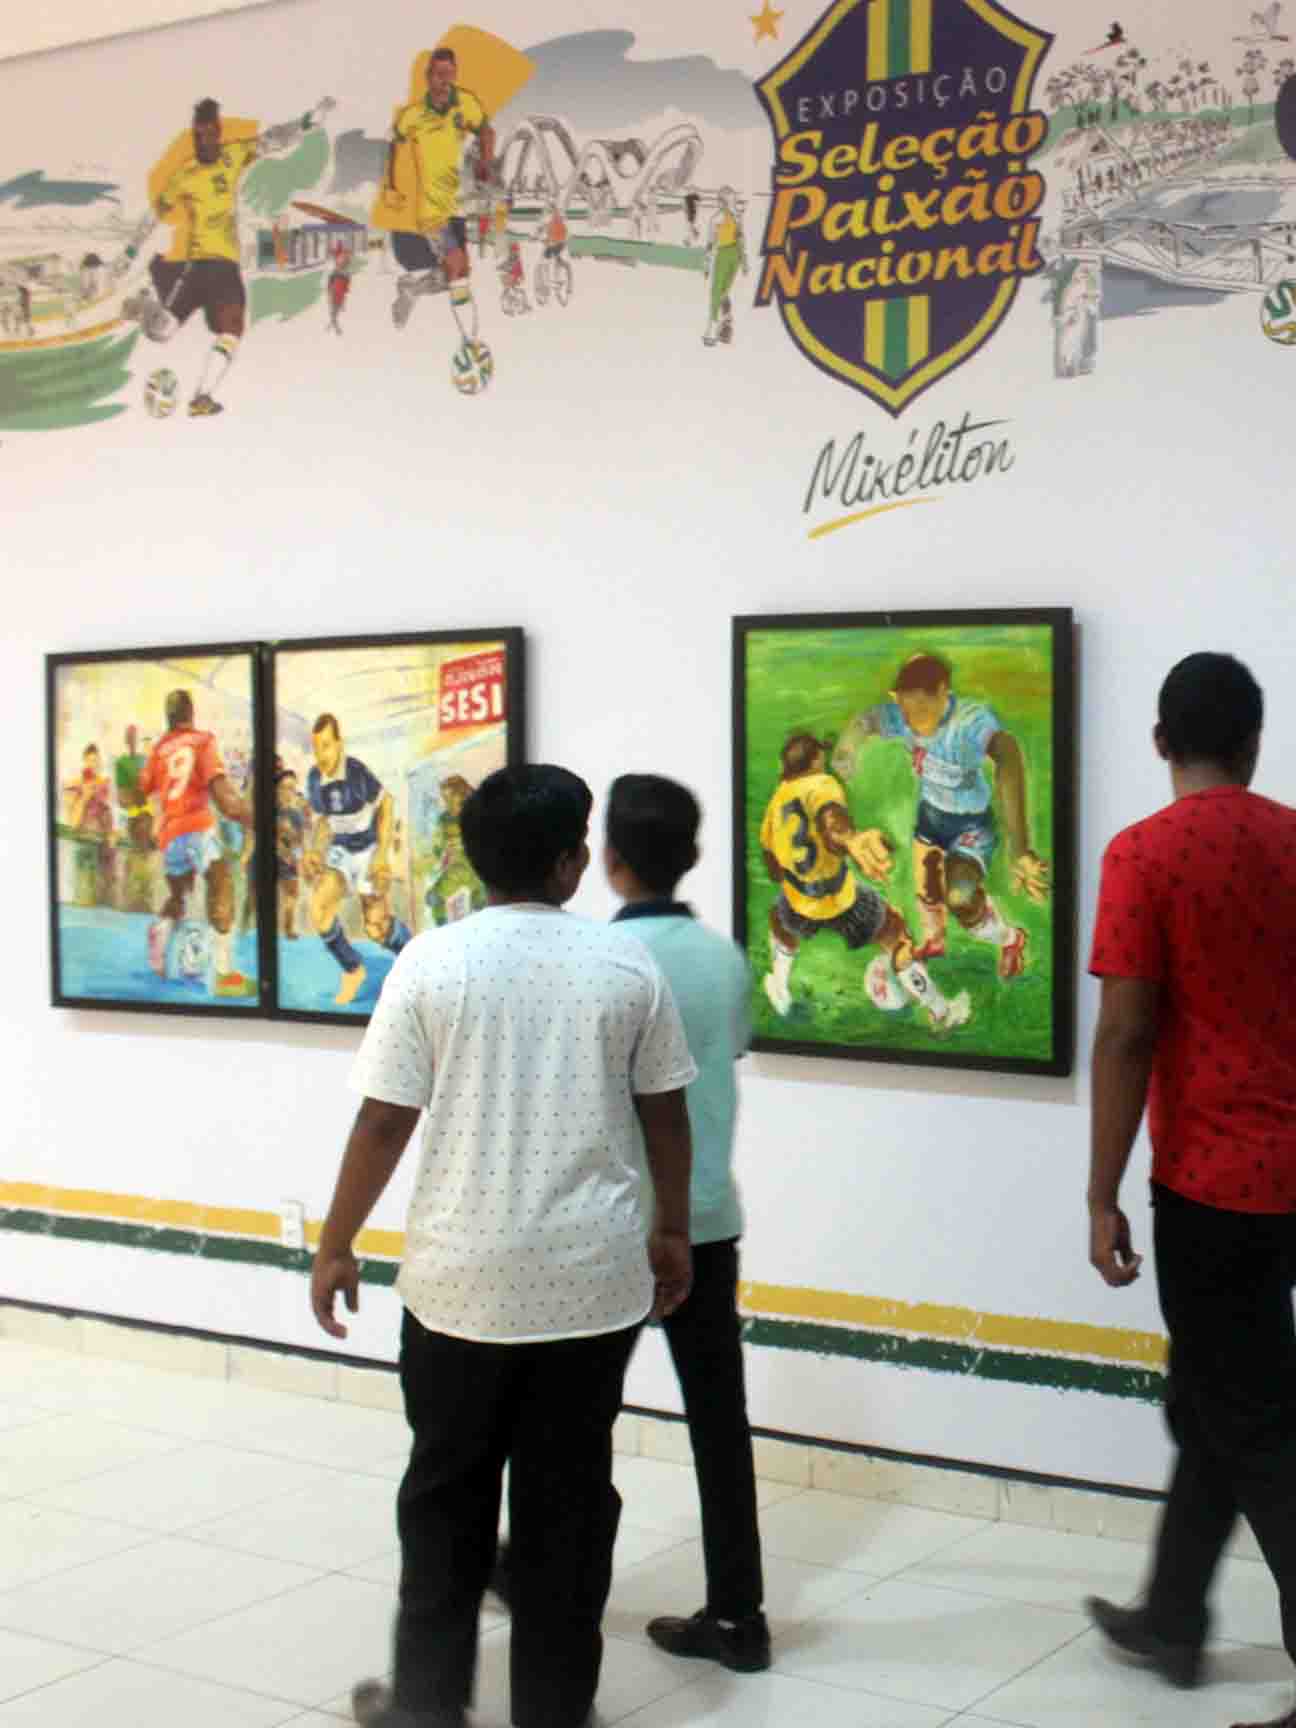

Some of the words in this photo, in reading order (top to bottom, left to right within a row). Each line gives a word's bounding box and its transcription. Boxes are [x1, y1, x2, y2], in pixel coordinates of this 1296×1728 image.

[798, 67, 1007, 122] EXPOSIÇÃO
[775, 111, 1045, 184] Seleção
[767, 167, 1043, 248] Paixão
[760, 220, 1041, 300] Nacional
[803, 411, 1015, 513] Mikéliton
[440, 682, 504, 722] SESI
[781, 797, 817, 875] 3
